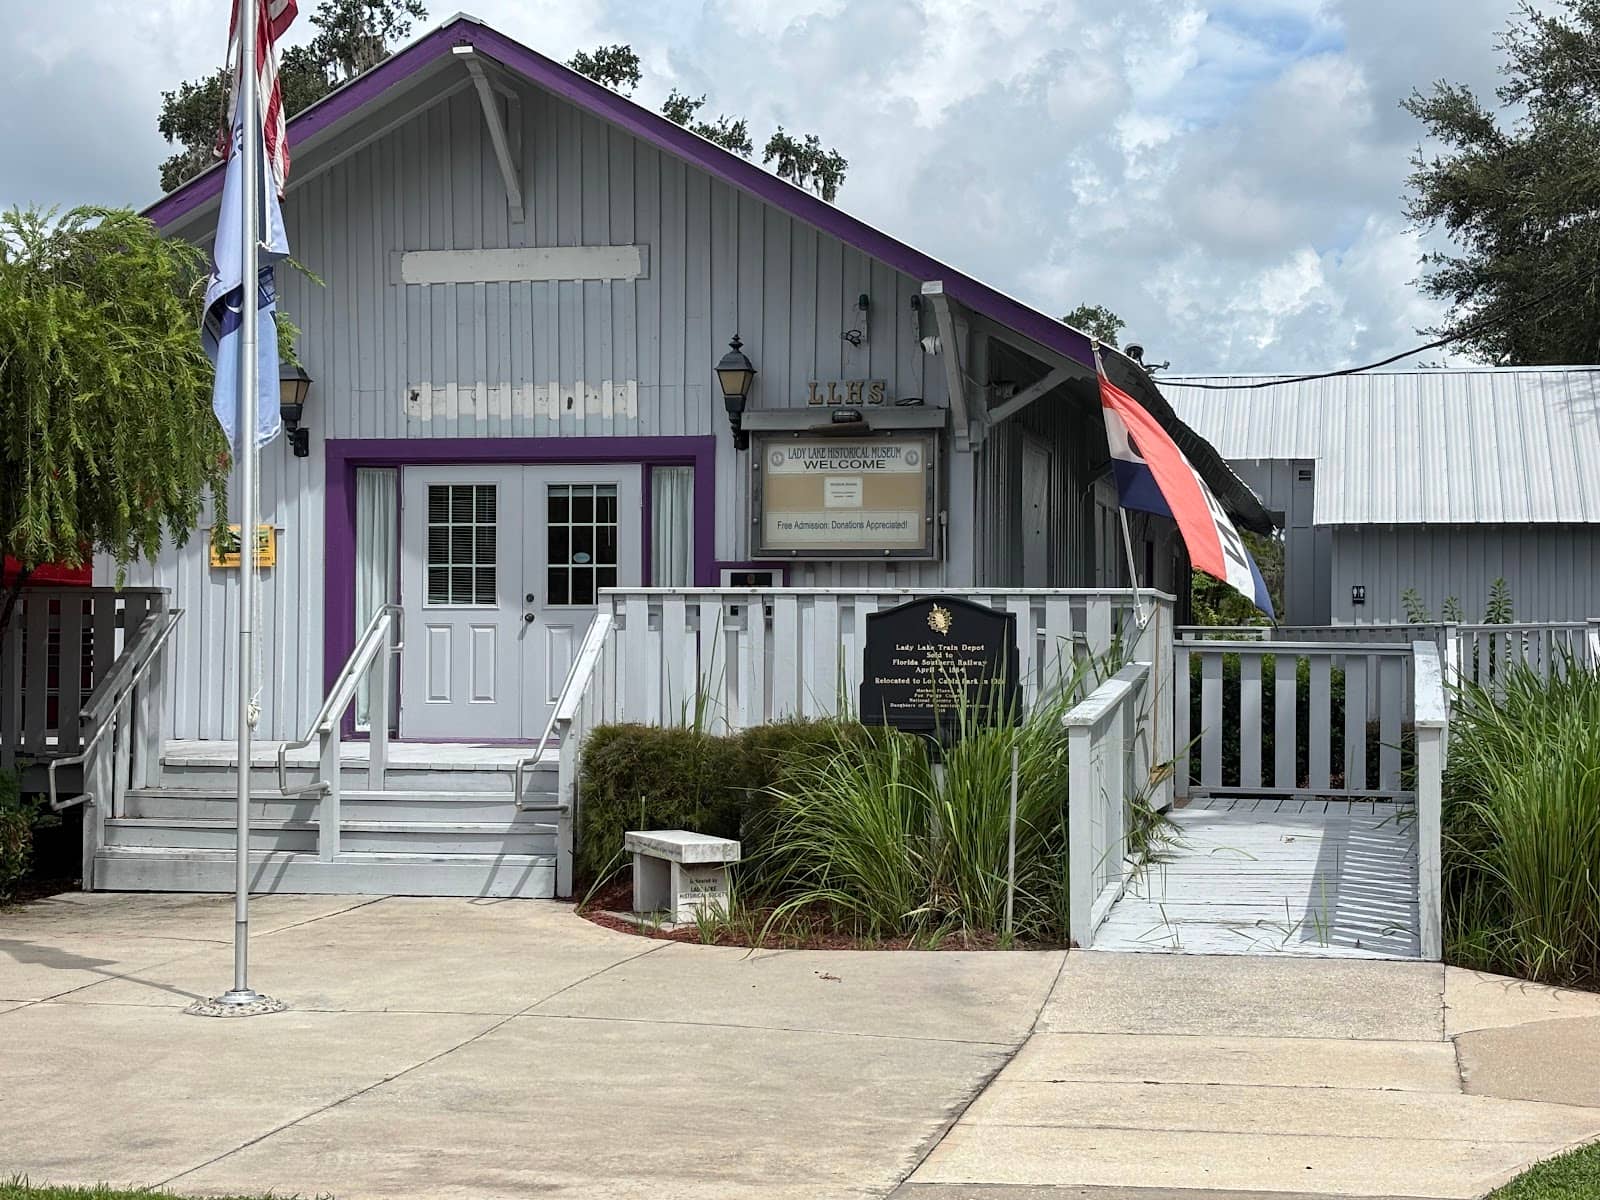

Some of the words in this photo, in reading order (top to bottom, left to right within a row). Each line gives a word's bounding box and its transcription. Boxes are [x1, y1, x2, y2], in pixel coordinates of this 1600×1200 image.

[808, 382, 886, 405] LLHS
[788, 447, 806, 459] LADY
[808, 447, 826, 459] LAKE
[827, 447, 869, 459] HISTORICAL
[871, 447, 902, 459] MUSEUM
[803, 460, 887, 470] WELCOME
[777, 520, 793, 530] Free
[831, 520, 865, 530] Donations
[866, 519, 908, 531] Appreciated!
[895, 644, 914, 652] Lady
[961, 644, 985, 652] Depot
[926, 651, 943, 659] Sold
[957, 659, 987, 667] Railway
[874, 677, 910, 685] Relocated
[912, 677, 921, 685] to
